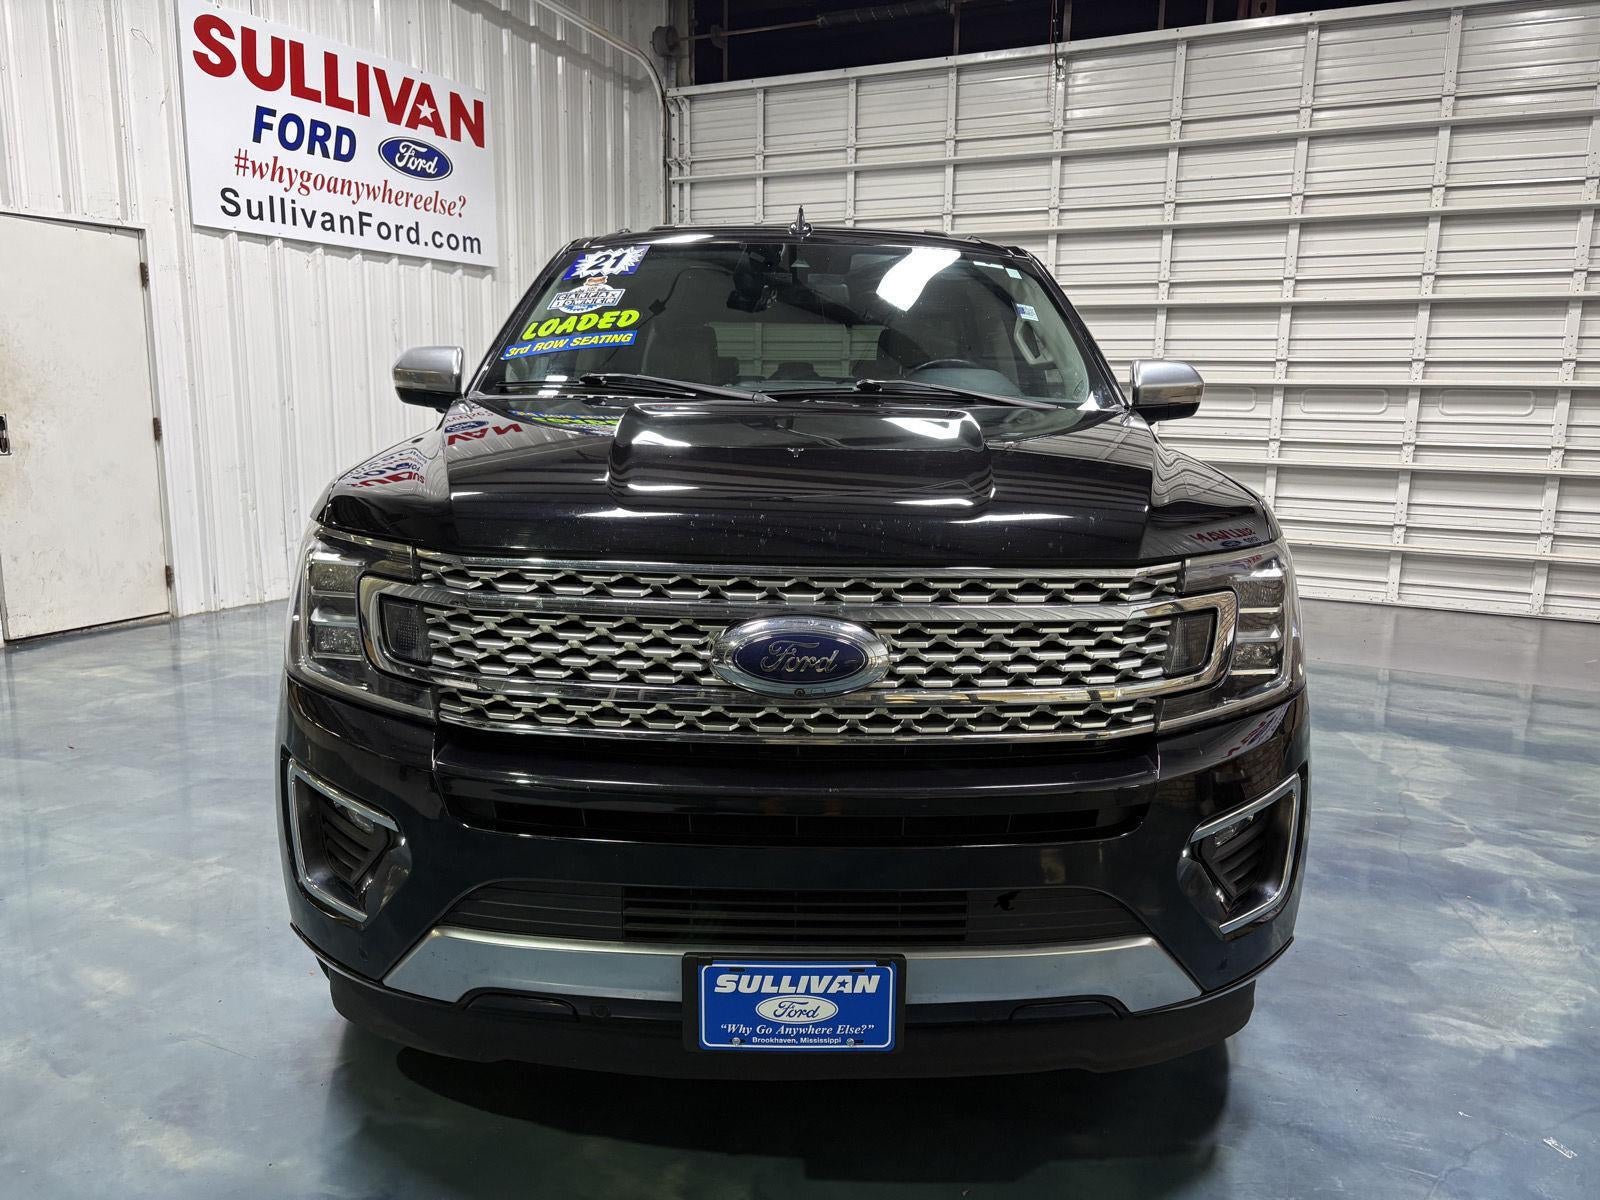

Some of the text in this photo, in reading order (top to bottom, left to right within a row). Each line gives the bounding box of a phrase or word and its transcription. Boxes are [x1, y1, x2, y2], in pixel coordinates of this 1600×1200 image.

[192, 13, 486, 149] SULLIVAN
[252, 105, 357, 163] FORD
[395, 140, 438, 176] Ford
[234, 148, 467, 218] #whygoanywhereelse?
[219, 187, 482, 255] SullivanFord.com
[521, 309, 641, 341] LOADED
[505, 332, 633, 357] 3rd ROW SEATING
[760, 640, 840, 674] Ford
[714, 974, 881, 994] SULLIVAN
[773, 1000, 821, 1019] Ford
[752, 1036, 842, 1045] Brookhaven, Mississippi
[756, 1025, 773, 1034] Go
[776, 1024, 833, 1036] Anywhere
